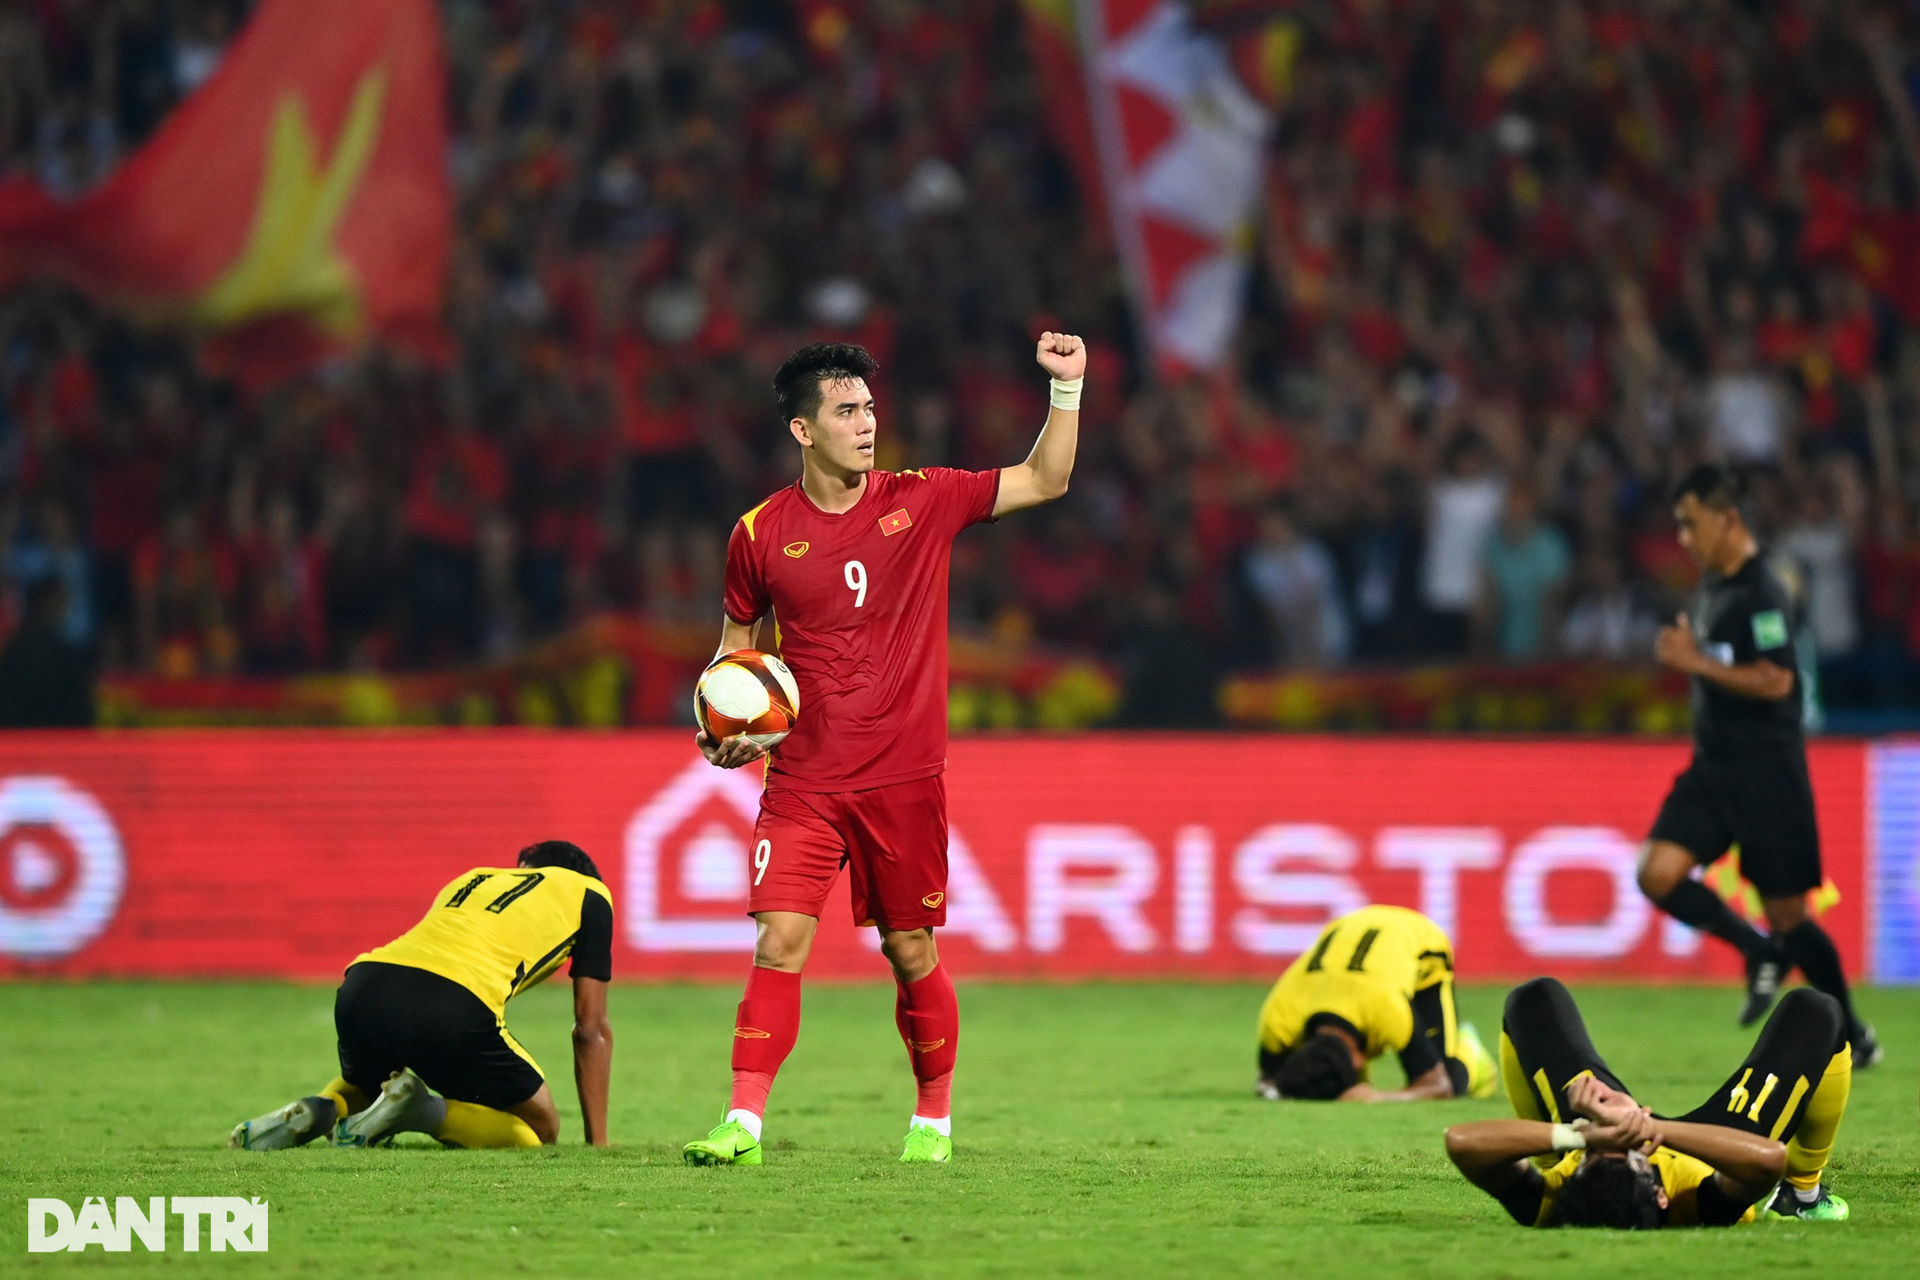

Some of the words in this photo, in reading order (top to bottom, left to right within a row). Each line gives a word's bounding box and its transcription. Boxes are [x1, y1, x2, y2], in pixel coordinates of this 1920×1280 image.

[843, 559, 868, 608] 9
[754, 838, 772, 886] 9
[445, 872, 546, 914] 17
[858, 823, 1766, 958] ARISTO
[1306, 928, 1381, 973] 11
